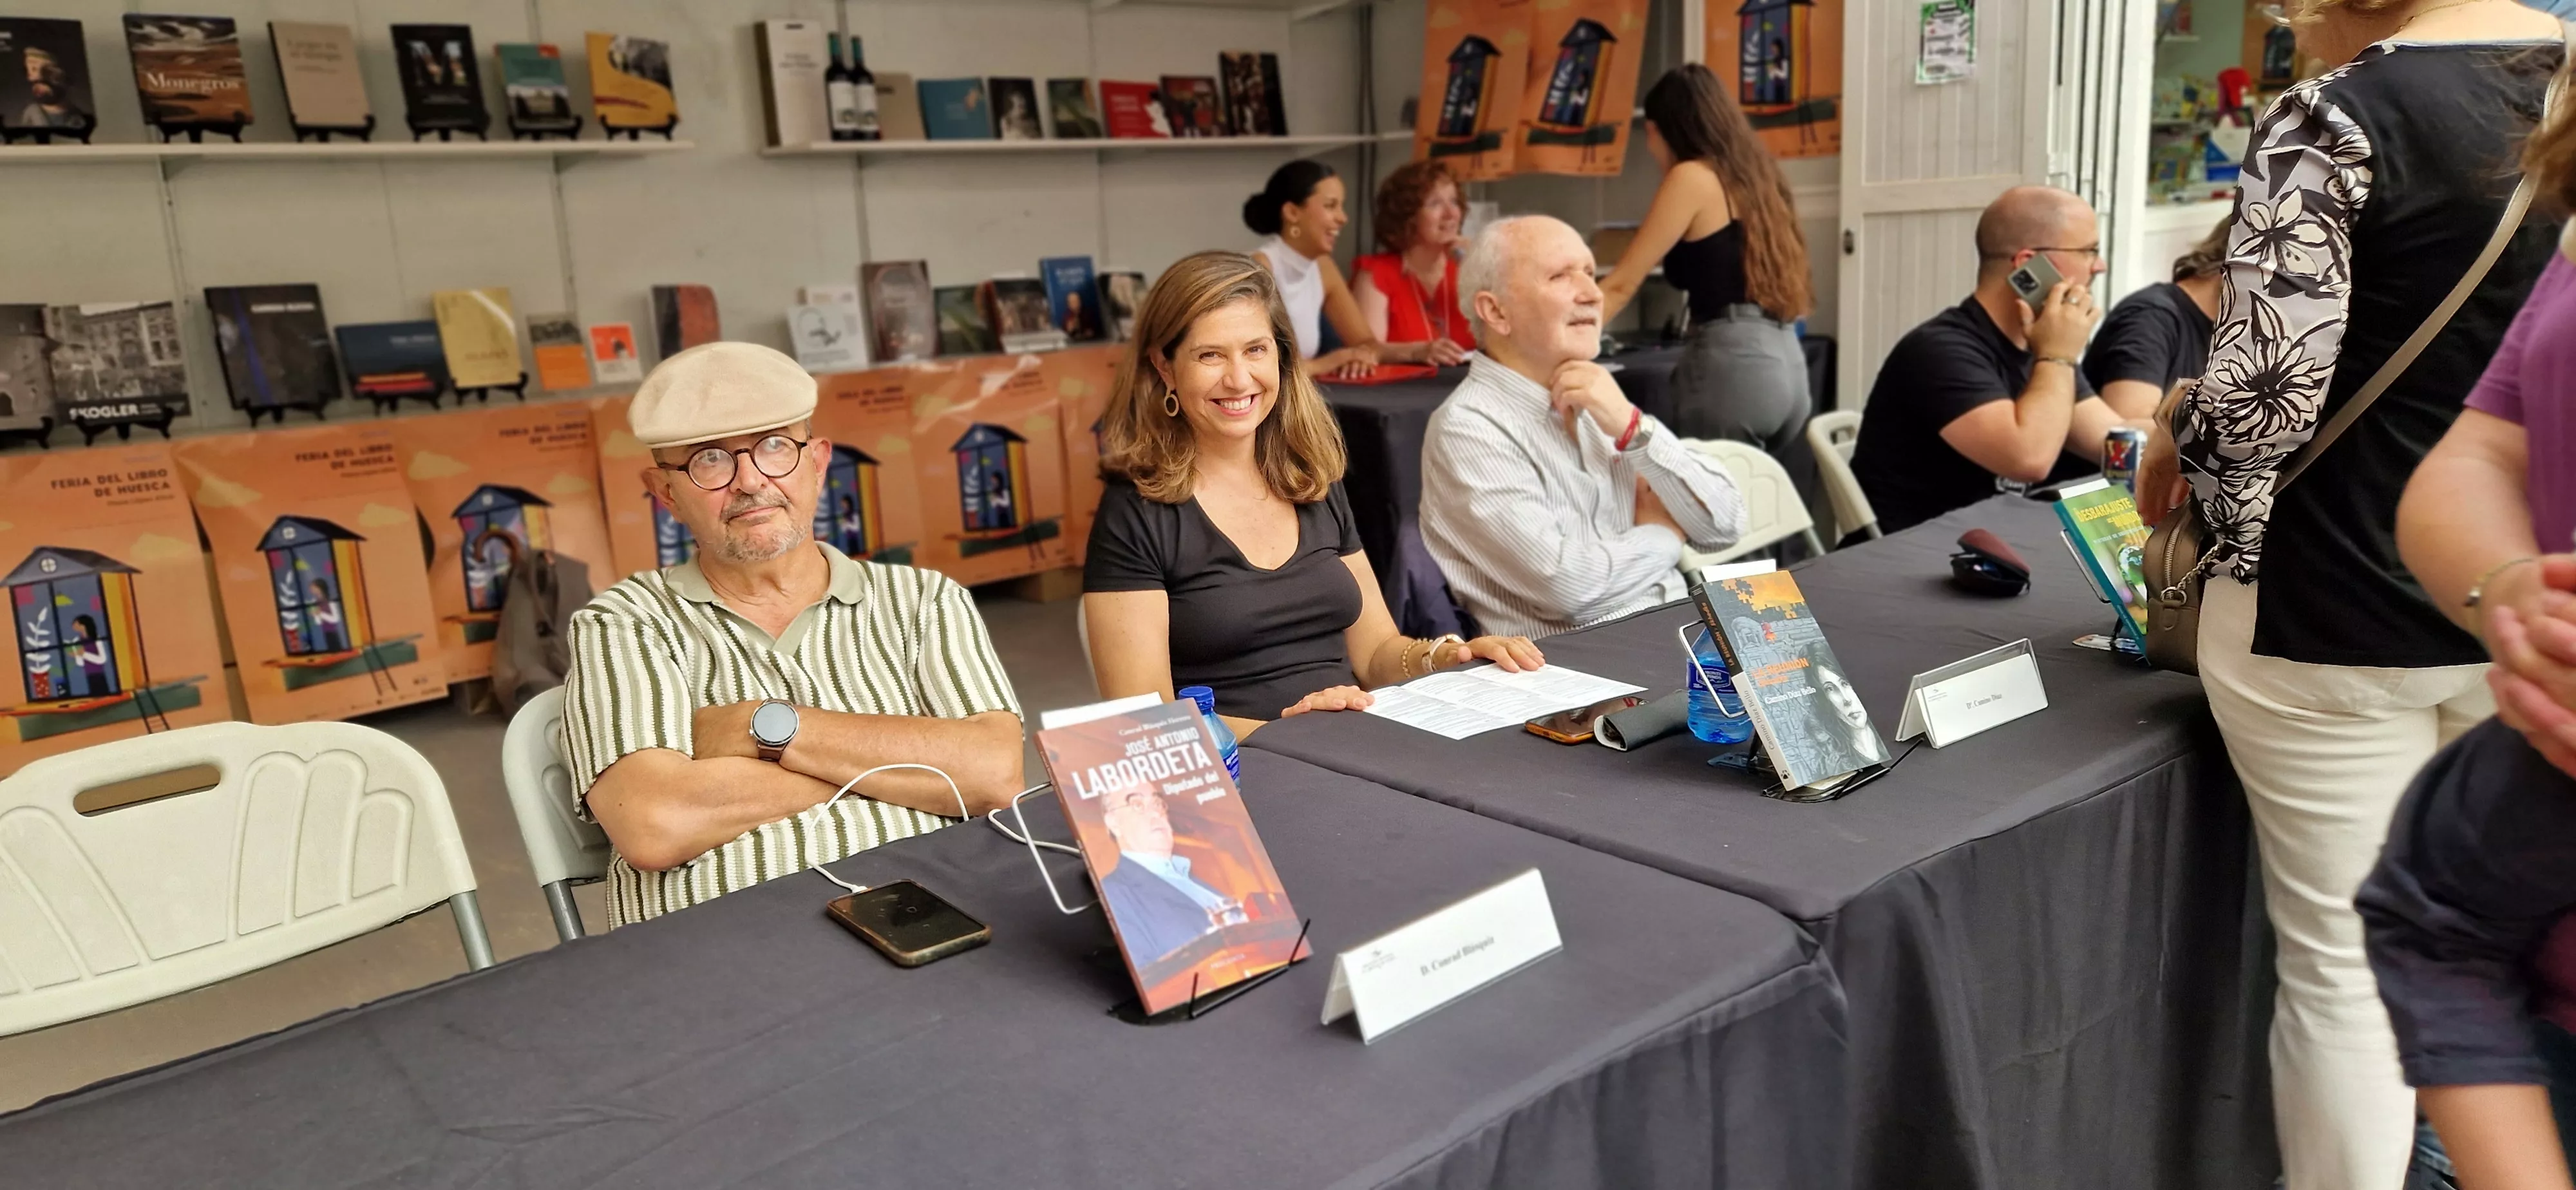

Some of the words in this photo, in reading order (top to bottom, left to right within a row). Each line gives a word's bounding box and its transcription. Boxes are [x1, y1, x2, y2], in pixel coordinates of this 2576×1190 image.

[147, 73, 240, 94] Monegros
[51, 477, 91, 489] FERIA
[97, 473, 122, 484] DEL
[128, 469, 167, 482] LIBRO
[94, 487, 111, 498] DE
[117, 481, 171, 495] HUESCA
[1744, 690, 1755, 708] Bello
[1765, 694, 1788, 704] Camino
[1801, 686, 1816, 695] Bello
[1125, 736, 1153, 757] JOSÉ
[1154, 726, 1200, 749] ANTONIO
[1761, 724, 1775, 750] Camino
[1071, 741, 1213, 800] LABORDETA
[1205, 771, 1220, 784] del
